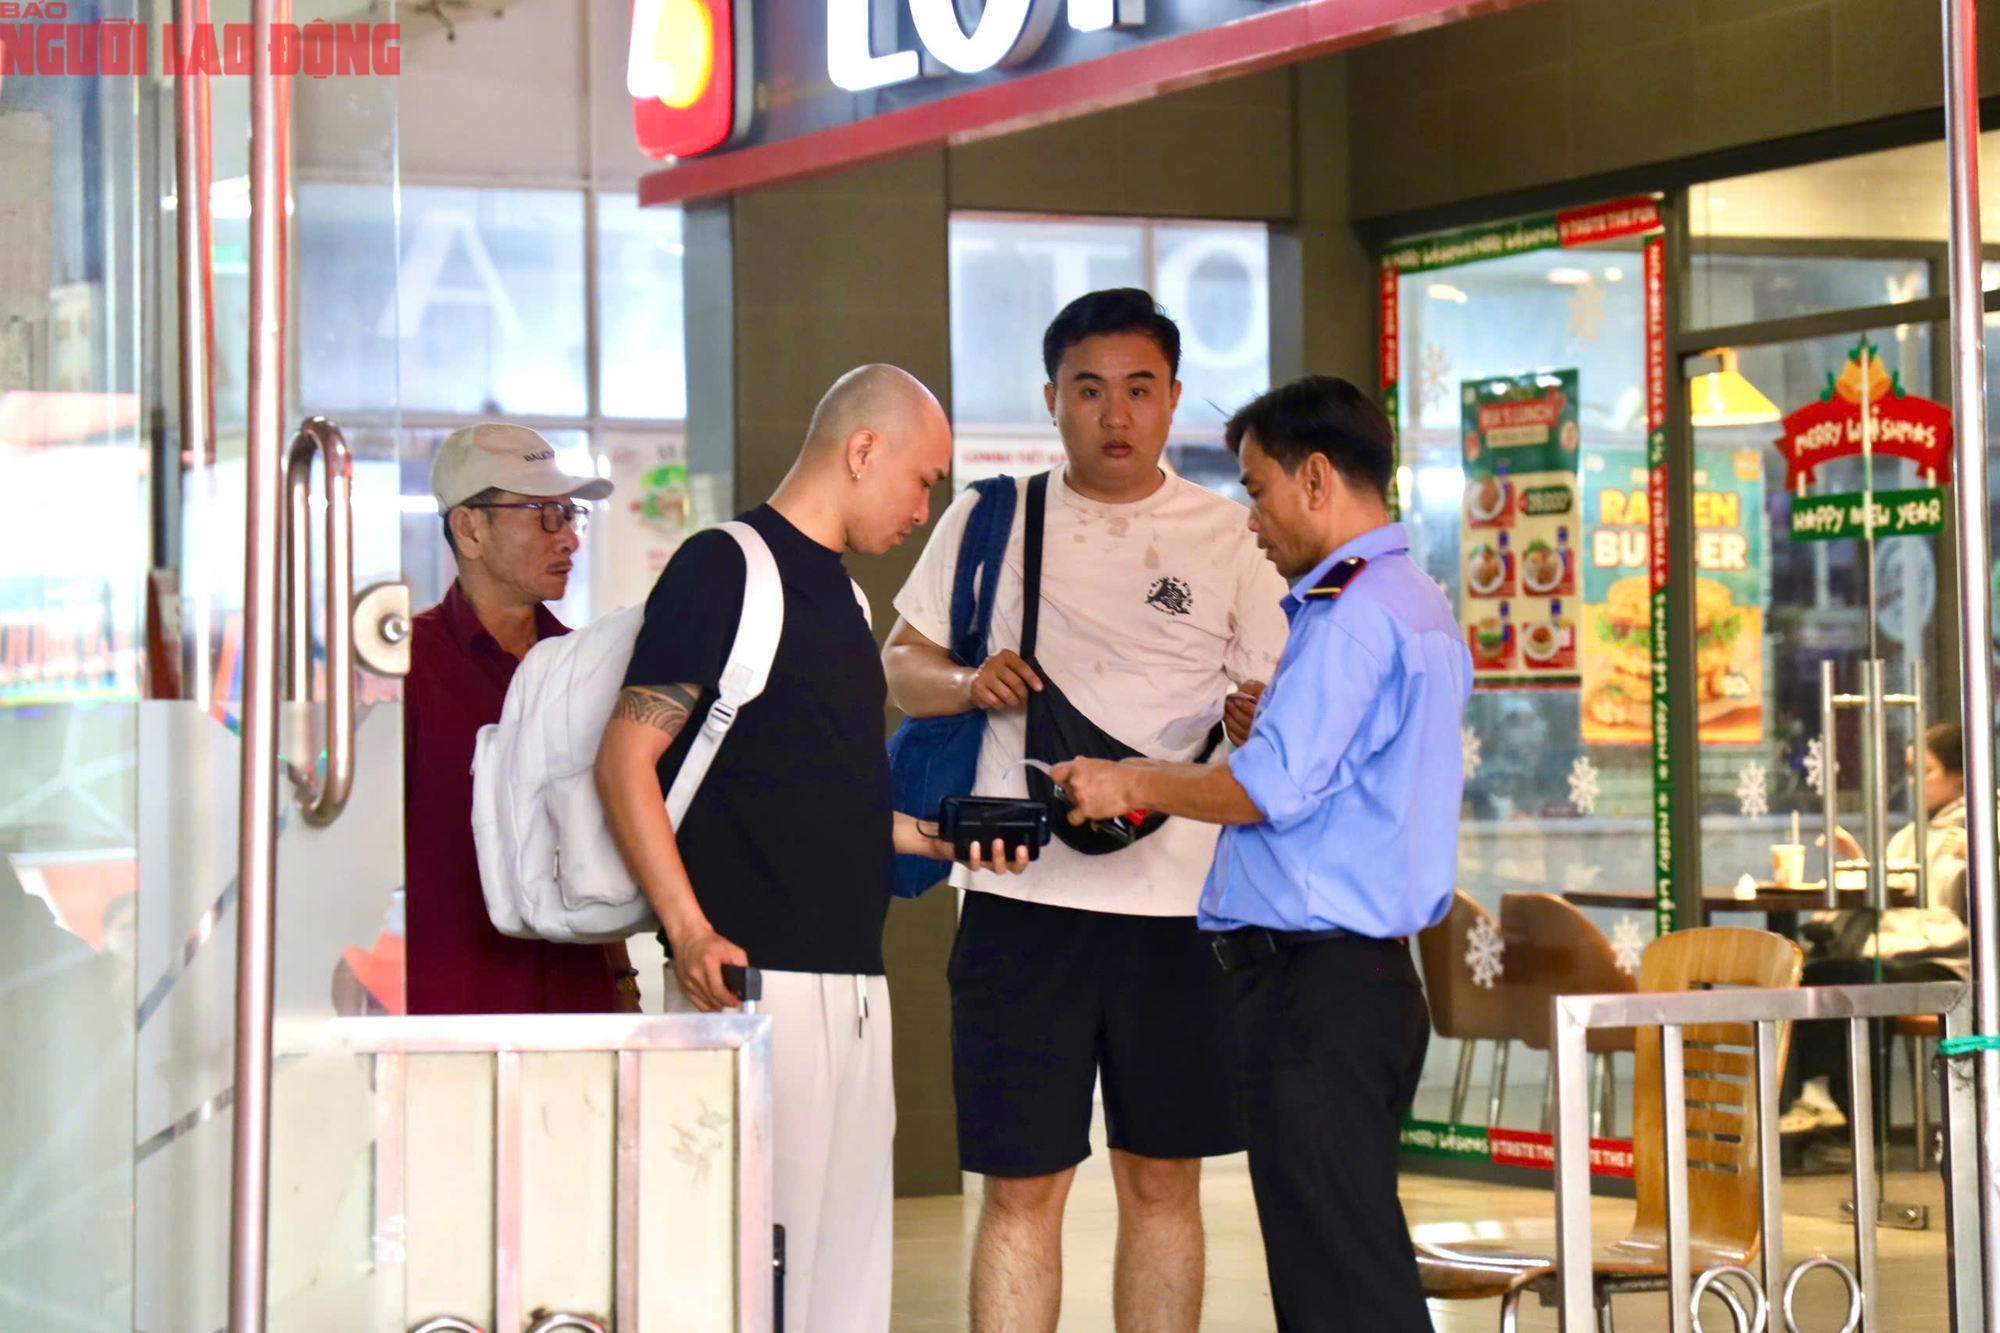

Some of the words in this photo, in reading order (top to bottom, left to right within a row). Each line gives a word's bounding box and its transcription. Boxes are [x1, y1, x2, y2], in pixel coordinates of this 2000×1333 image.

[1795, 420, 1843, 457] MERRY
[1793, 503, 1846, 534] HAPPY
[1896, 498, 1942, 531] YEAR
[1593, 530, 1749, 571] BUER
